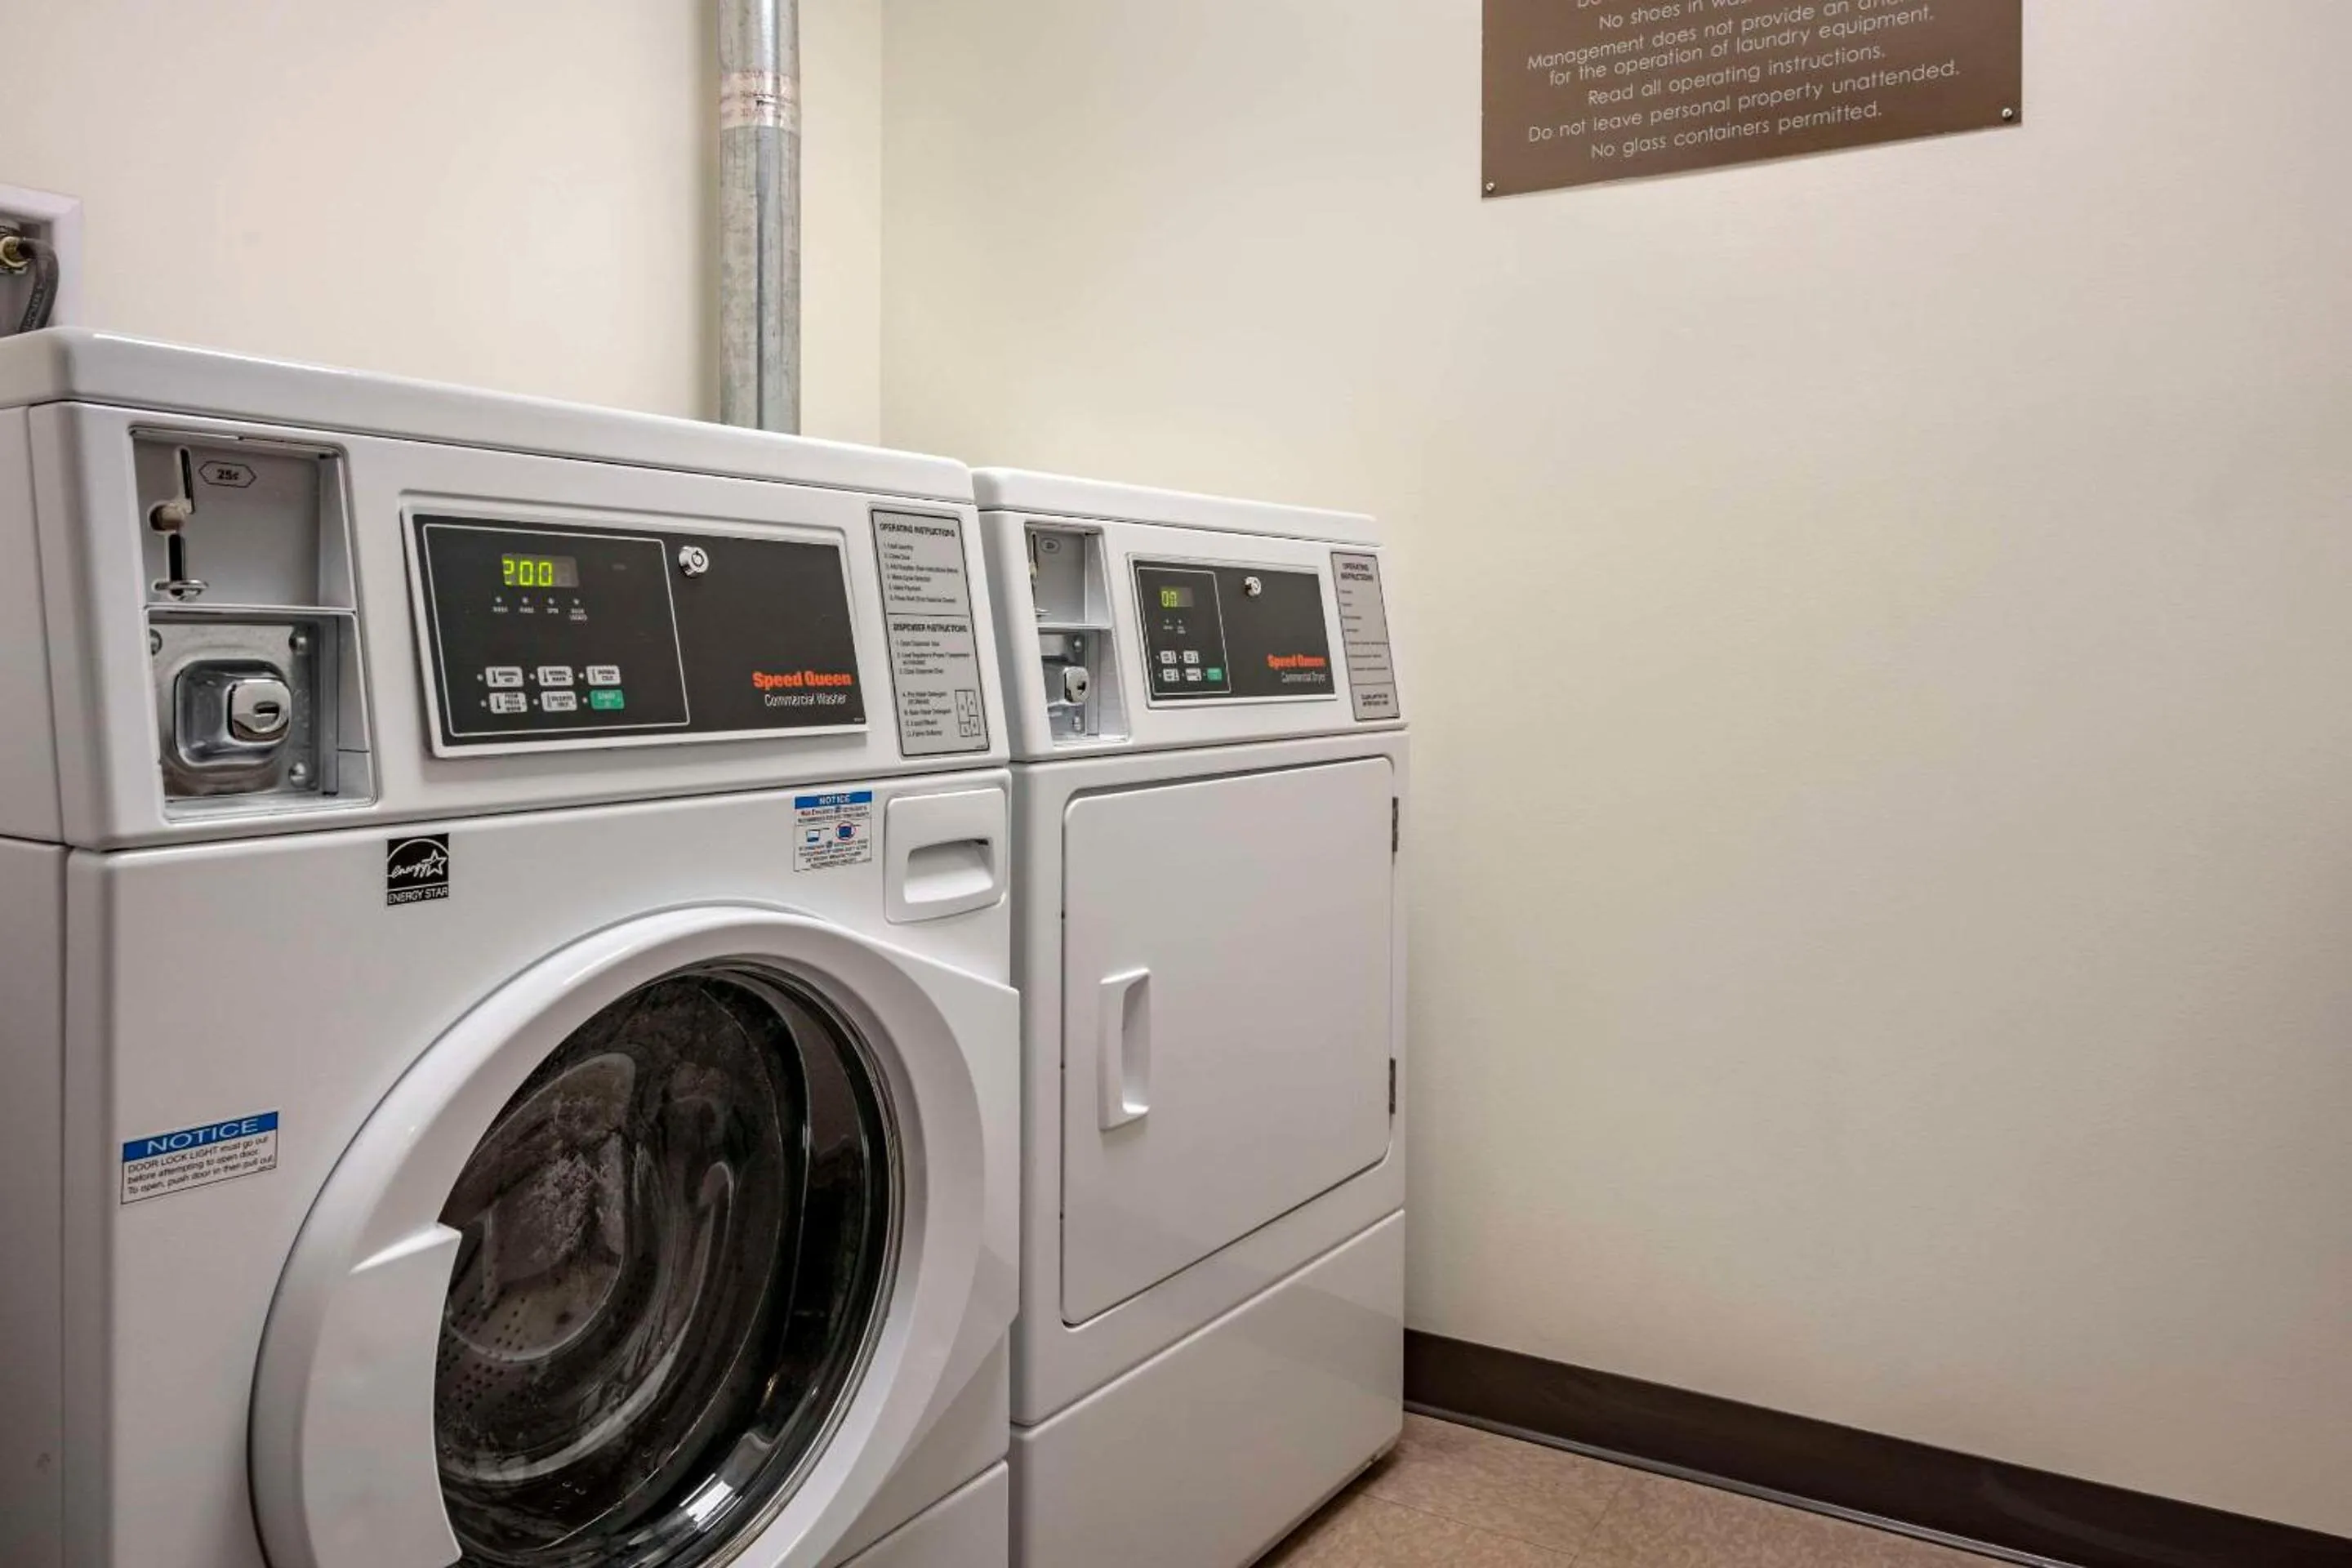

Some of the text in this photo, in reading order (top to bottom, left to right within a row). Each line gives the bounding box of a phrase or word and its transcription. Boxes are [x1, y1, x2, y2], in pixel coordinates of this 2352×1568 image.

[1599, 13, 1624, 29] No
[1630, 3, 1681, 24] shoes
[1526, 33, 1644, 70] Management
[1651, 27, 1696, 48] does
[1704, 18, 1733, 38] not
[1741, 5, 1815, 34] provide
[1823, 1, 1849, 16] an
[1549, 69, 1572, 86] for
[1578, 63, 1607, 81] the
[1614, 47, 1703, 76] operation
[1710, 39, 1730, 58] of
[1736, 28, 1811, 54] laundry
[1818, 5, 1935, 38] equipment.
[1588, 44, 1886, 106] Read all operating instructions.
[1528, 59, 1961, 143] Do not leave personal property unattended.
[1591, 100, 1882, 158] No glass containers permitted.
[752, 670, 853, 691] Speed Queen
[764, 693, 847, 707] Commercial Washer
[818, 795, 851, 804] NOTICE
[388, 886, 448, 904] ENERGY STAR
[146, 1118, 260, 1155] NOTICE
[127, 1159, 158, 1174] DOOR
[161, 1153, 187, 1166] LOCK
[189, 1146, 219, 1160] LIGHT
[220, 1142, 241, 1152] must
[243, 1140, 254, 1150] go
[127, 1172, 156, 1184] before
[158, 1161, 204, 1177] attempting
[206, 1158, 215, 1166] to
[216, 1153, 238, 1165] open
[167, 1175, 189, 1189] push
[191, 1169, 212, 1180] door
